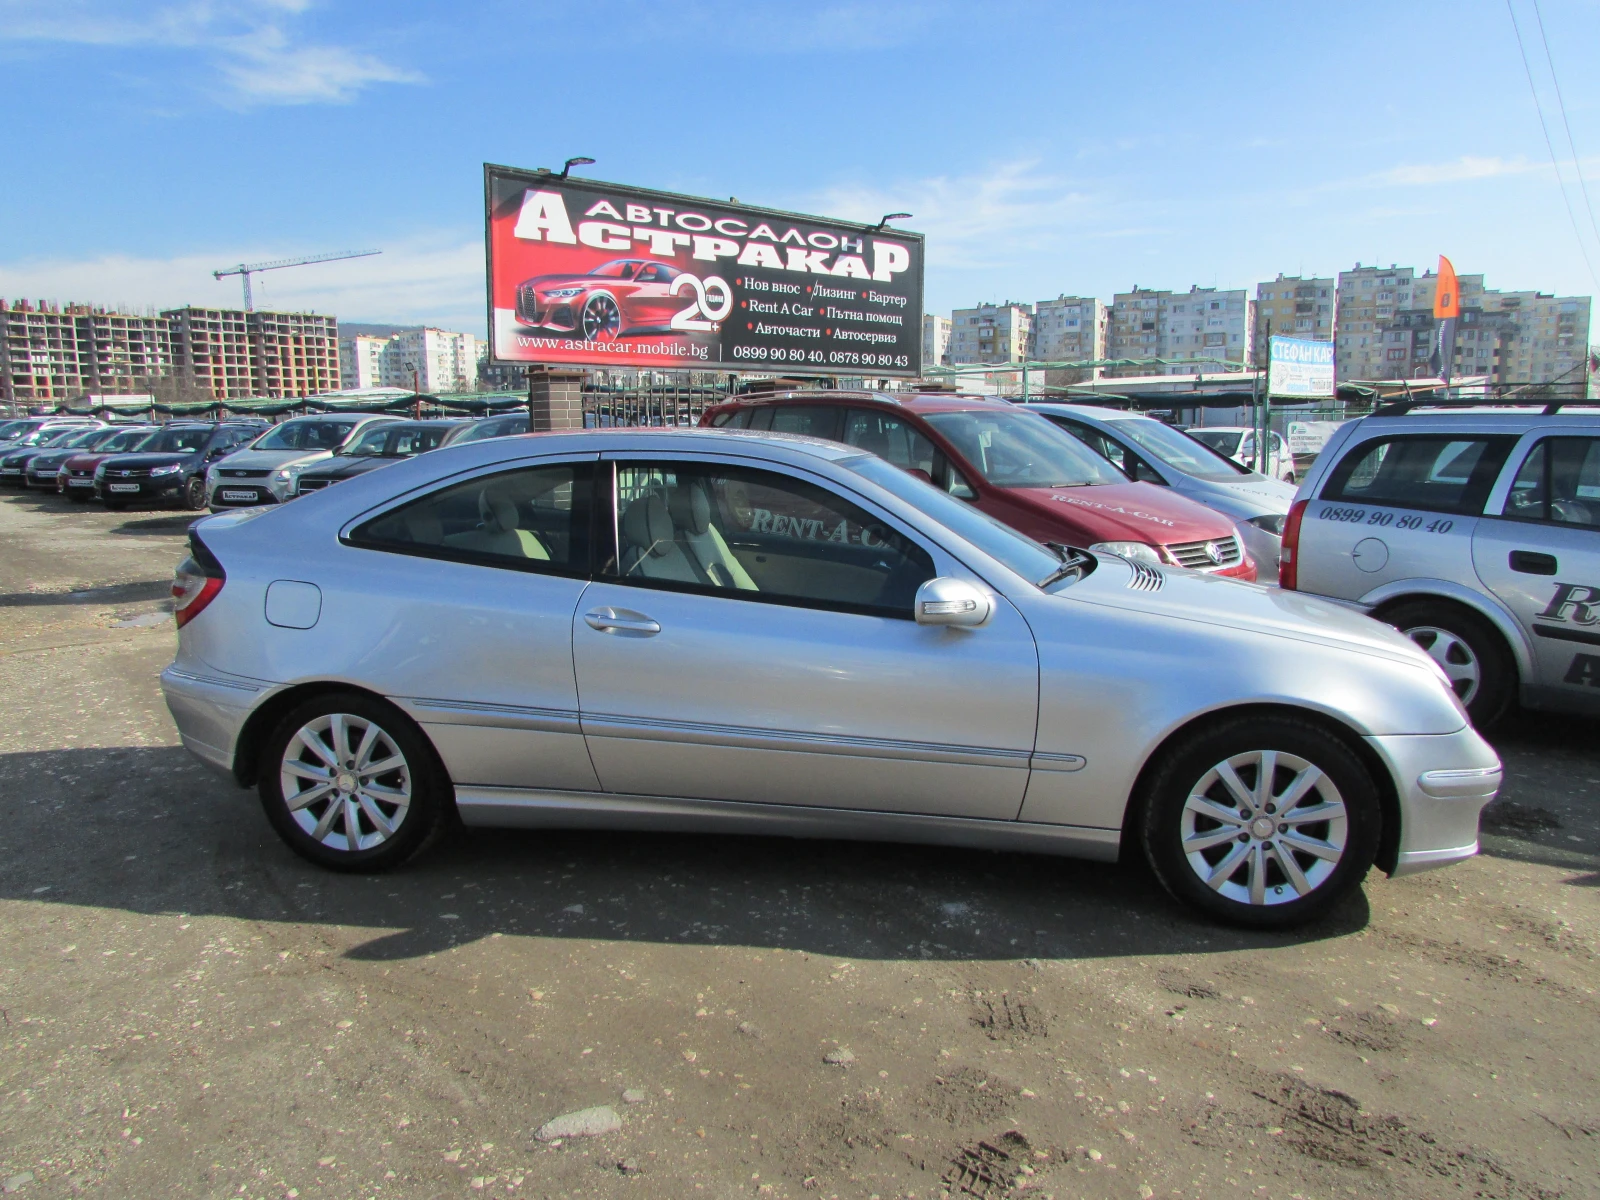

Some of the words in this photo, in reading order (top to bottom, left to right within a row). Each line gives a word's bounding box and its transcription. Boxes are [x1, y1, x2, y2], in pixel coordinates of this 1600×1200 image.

[585, 200, 863, 254] АВТОСАЛОН
[744, 277, 769, 291] Нов
[771, 280, 801, 295] внос
[814, 284, 857, 301] Лизинг
[749, 300, 779, 314] Rent
[780, 303, 790, 315] A
[792, 303, 814, 317] Car
[868, 291, 907, 308] Бартер
[826, 307, 863, 322] Пътна
[865, 312, 903, 326] помощ
[754, 322, 821, 338] Авточасти
[833, 327, 897, 345] Автосервиз
[516, 336, 709, 360] www.astracar.mobile.bg
[733, 345, 768, 360] 0899
[770, 348, 786, 361] 90
[789, 349, 805, 362] 80
[807, 350, 827, 363] 40,
[829, 351, 859, 364] 0878
[861, 353, 876, 366] 90
[878, 354, 893, 366] 80
[894, 355, 908, 367] 43
[1273, 341, 1312, 362] СТЕФАН
[1049, 494, 1175, 527] RENT-A-CAR
[1319, 506, 1365, 523] 0899
[1367, 510, 1394, 527] 90
[1396, 514, 1423, 531] 80
[1426, 518, 1454, 535] 40
